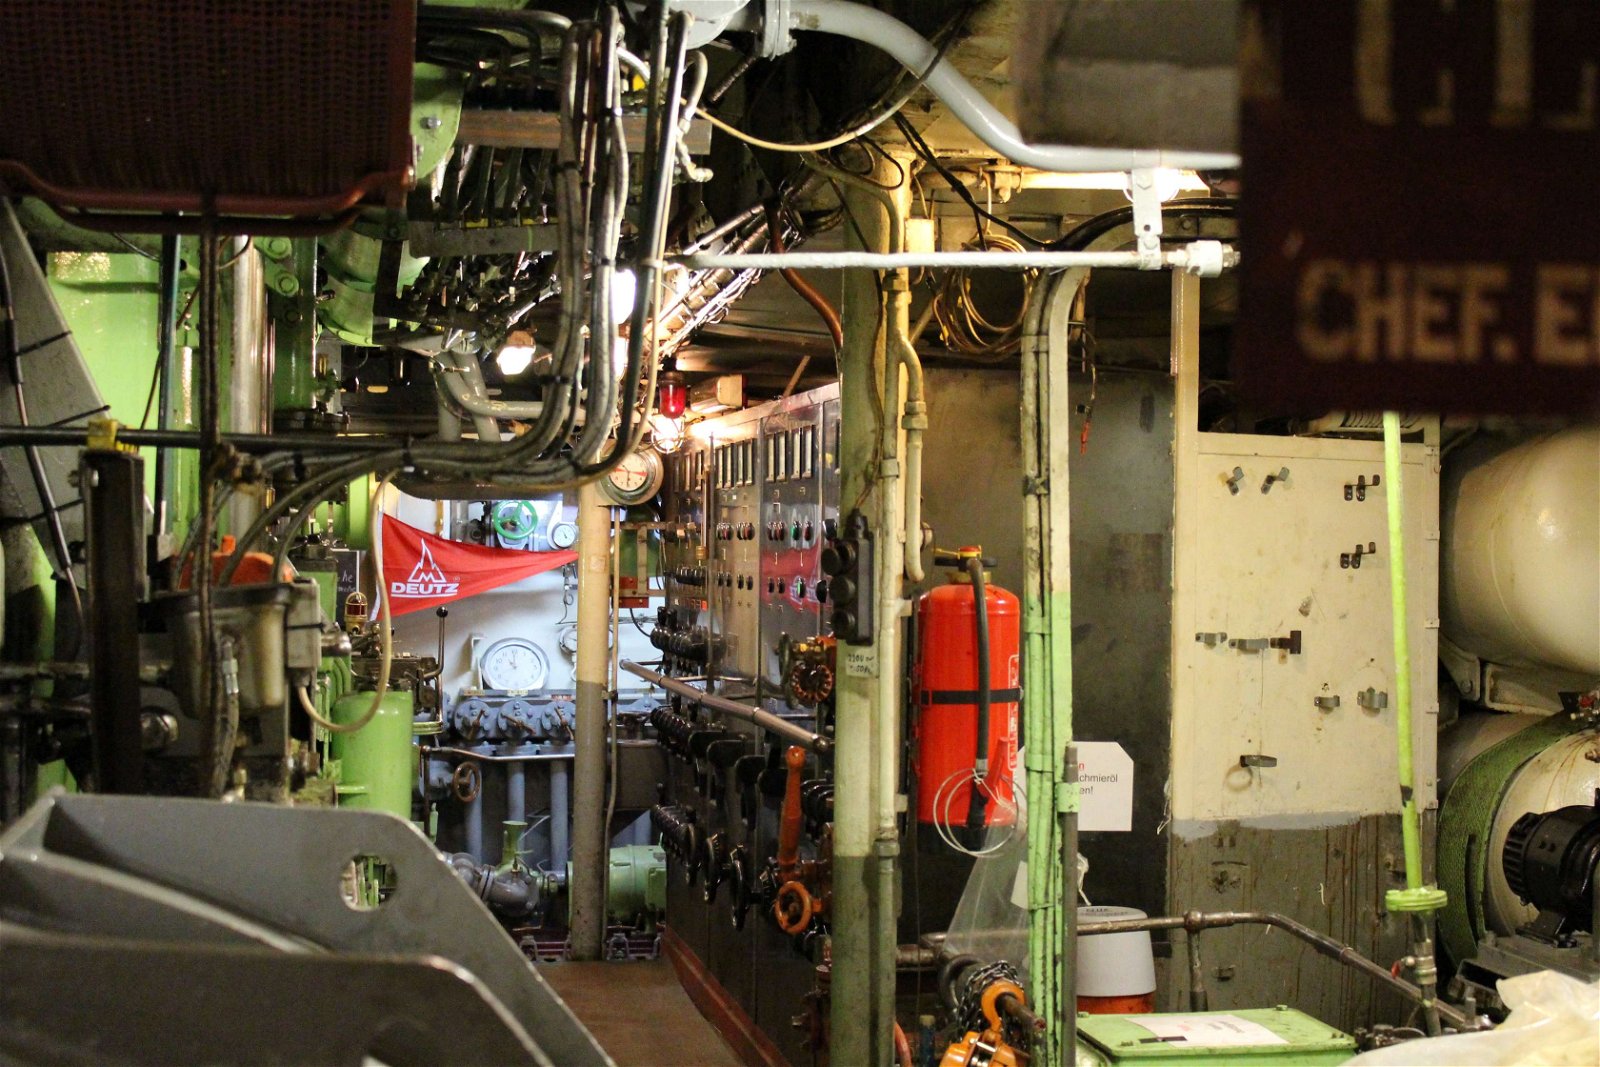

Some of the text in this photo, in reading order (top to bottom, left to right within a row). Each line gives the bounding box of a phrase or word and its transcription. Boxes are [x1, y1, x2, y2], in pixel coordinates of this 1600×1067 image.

[391, 582, 459, 594] DEUTZ
[1079, 773, 1118, 783] chmieröl
[1079, 786, 1094, 795] en!
